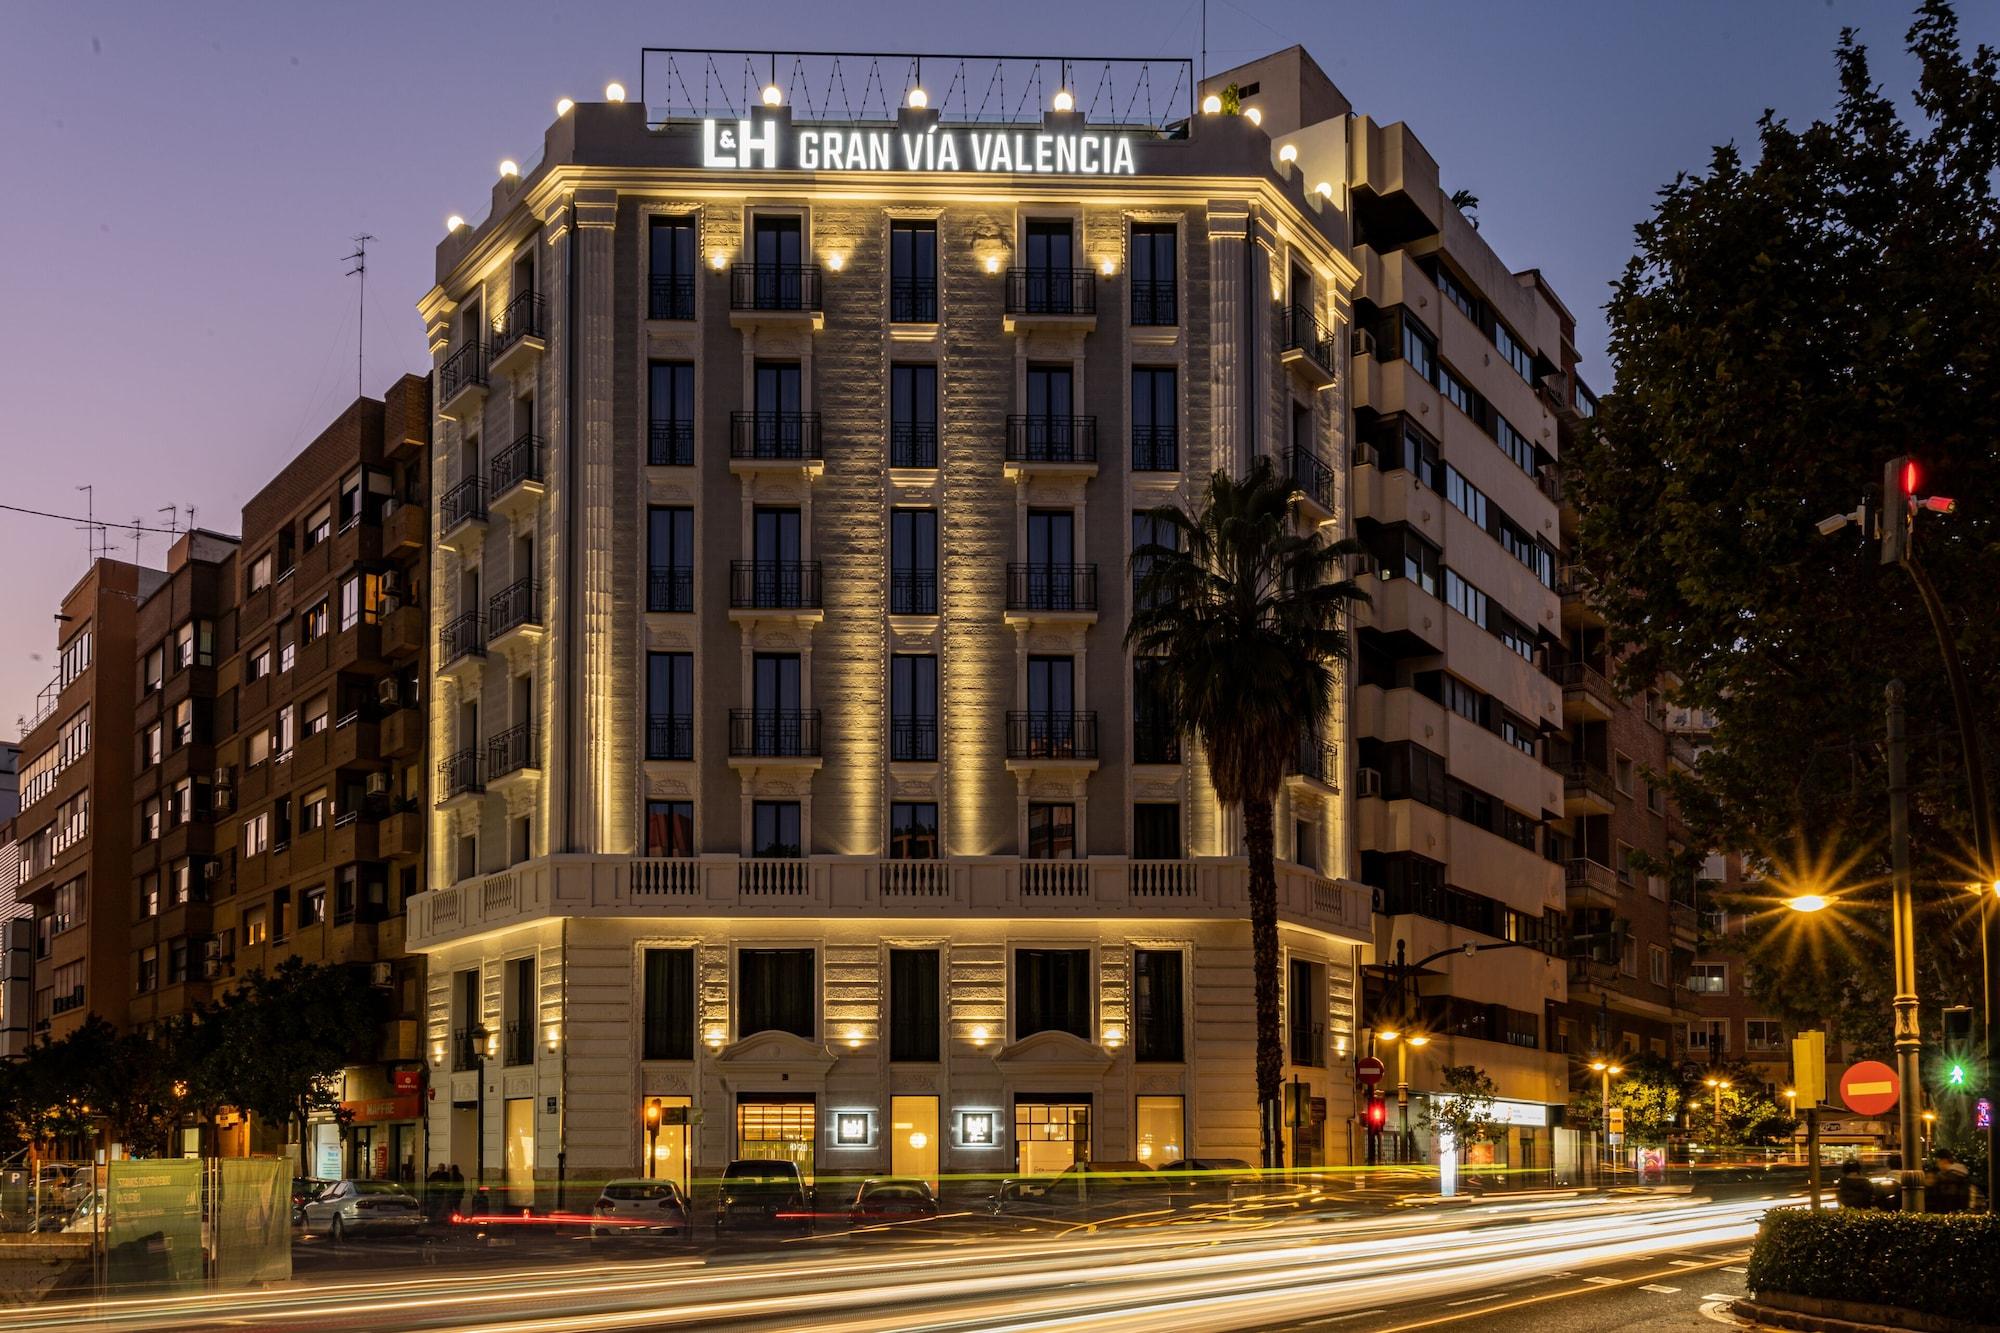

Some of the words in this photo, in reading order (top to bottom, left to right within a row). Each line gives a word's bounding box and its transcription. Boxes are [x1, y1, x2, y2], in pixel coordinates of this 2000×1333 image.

[704, 119, 775, 168] L&H
[800, 132, 890, 170] GRAN
[902, 124, 959, 170] VÍA
[970, 133, 1135, 174] VALENCIA
[11, 1172, 21, 1184] P
